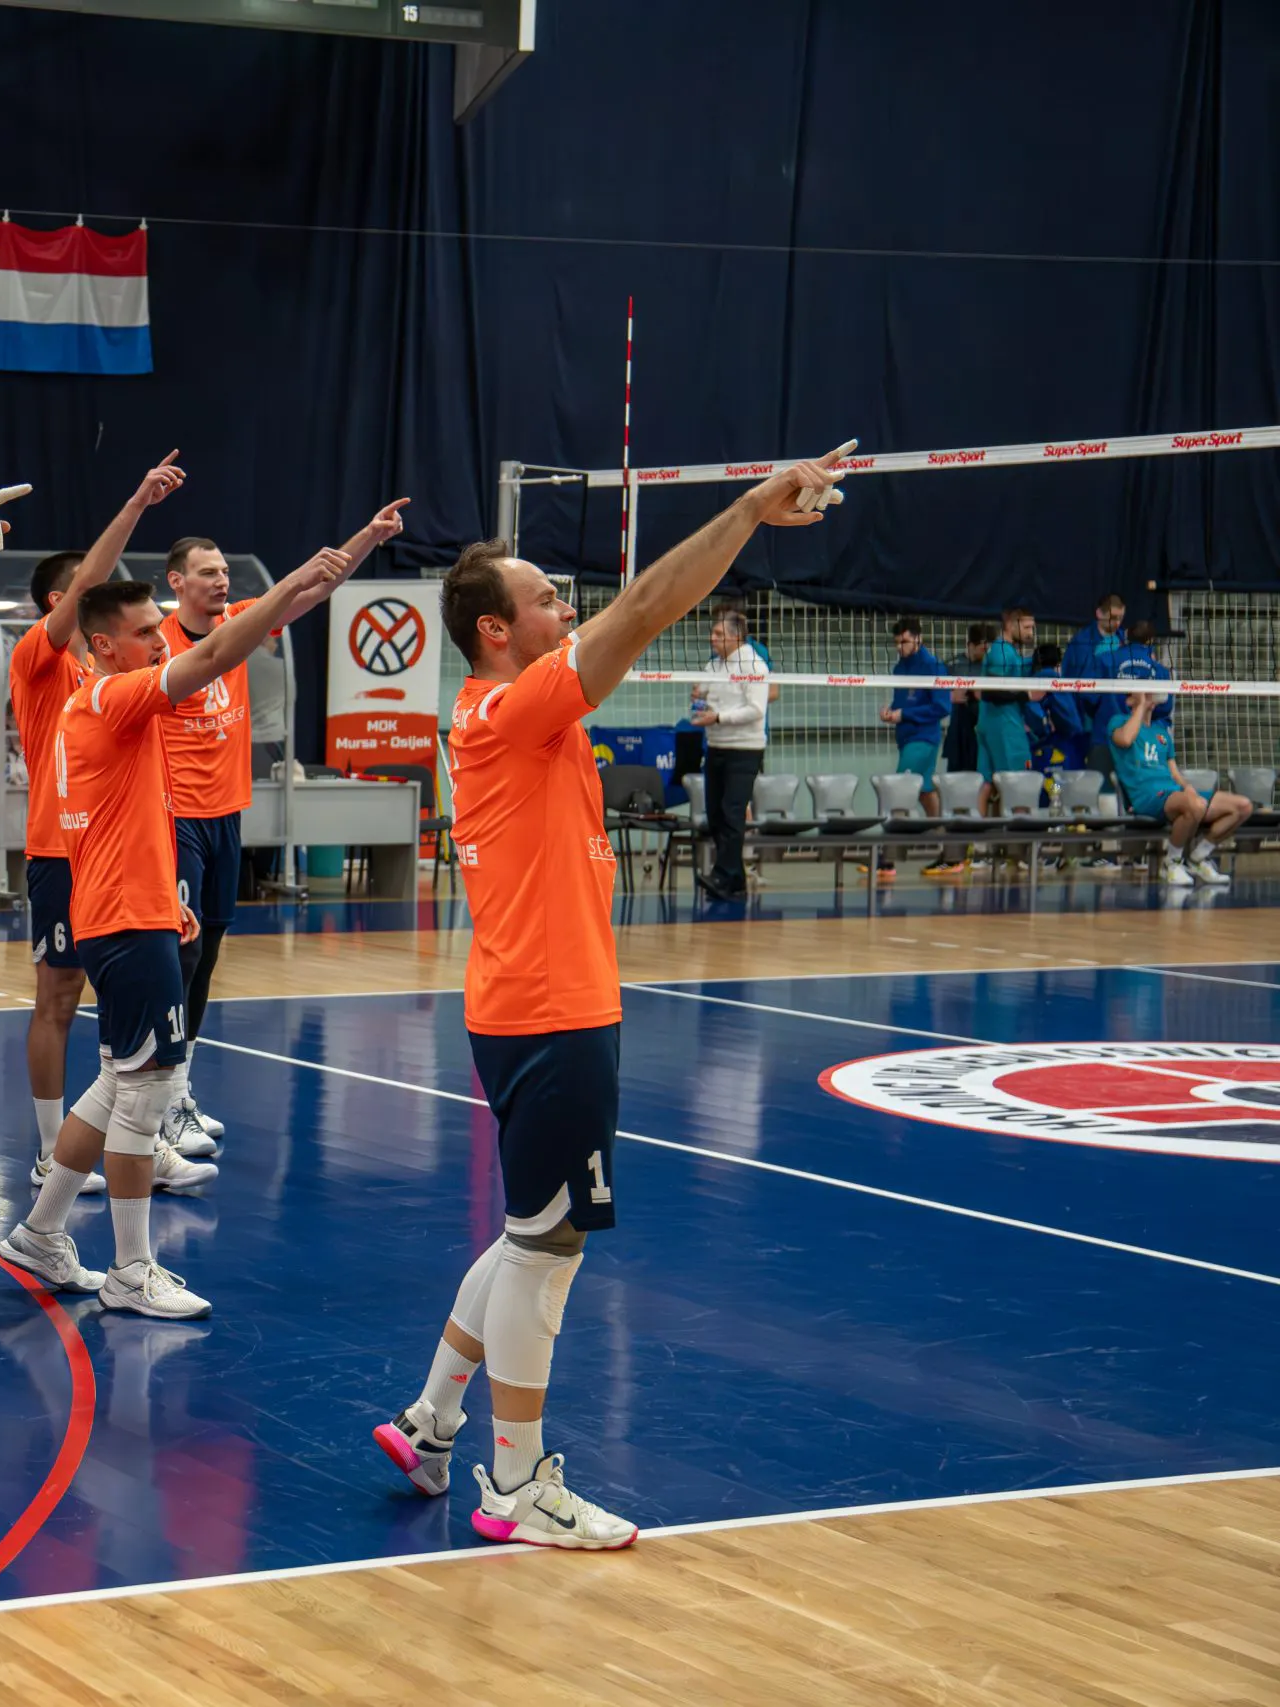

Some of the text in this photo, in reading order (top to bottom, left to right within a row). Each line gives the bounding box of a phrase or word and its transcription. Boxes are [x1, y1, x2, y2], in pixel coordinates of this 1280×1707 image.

[402, 6, 418, 22] 15
[1171, 432, 1243, 449] SuperSport
[1043, 443, 1108, 457] SuperSport
[831, 457, 875, 471] perSport
[927, 450, 986, 465] SuperSport
[637, 469, 680, 481] SuperSport
[724, 463, 774, 477] SuperSport
[730, 673, 765, 683] SuperSport
[827, 675, 866, 686] SuperSport
[934, 677, 976, 689] SuperSport
[1051, 679, 1096, 692] SuperSport
[1180, 681, 1231, 694] SuperSport
[366, 719, 398, 732] MOK
[335, 736, 378, 750] Mursa
[390, 735, 432, 751] Osijek
[54, 922, 67, 953] 6
[872, 1082, 1121, 1131] HOLDING
[587, 1150, 613, 1204] 1
